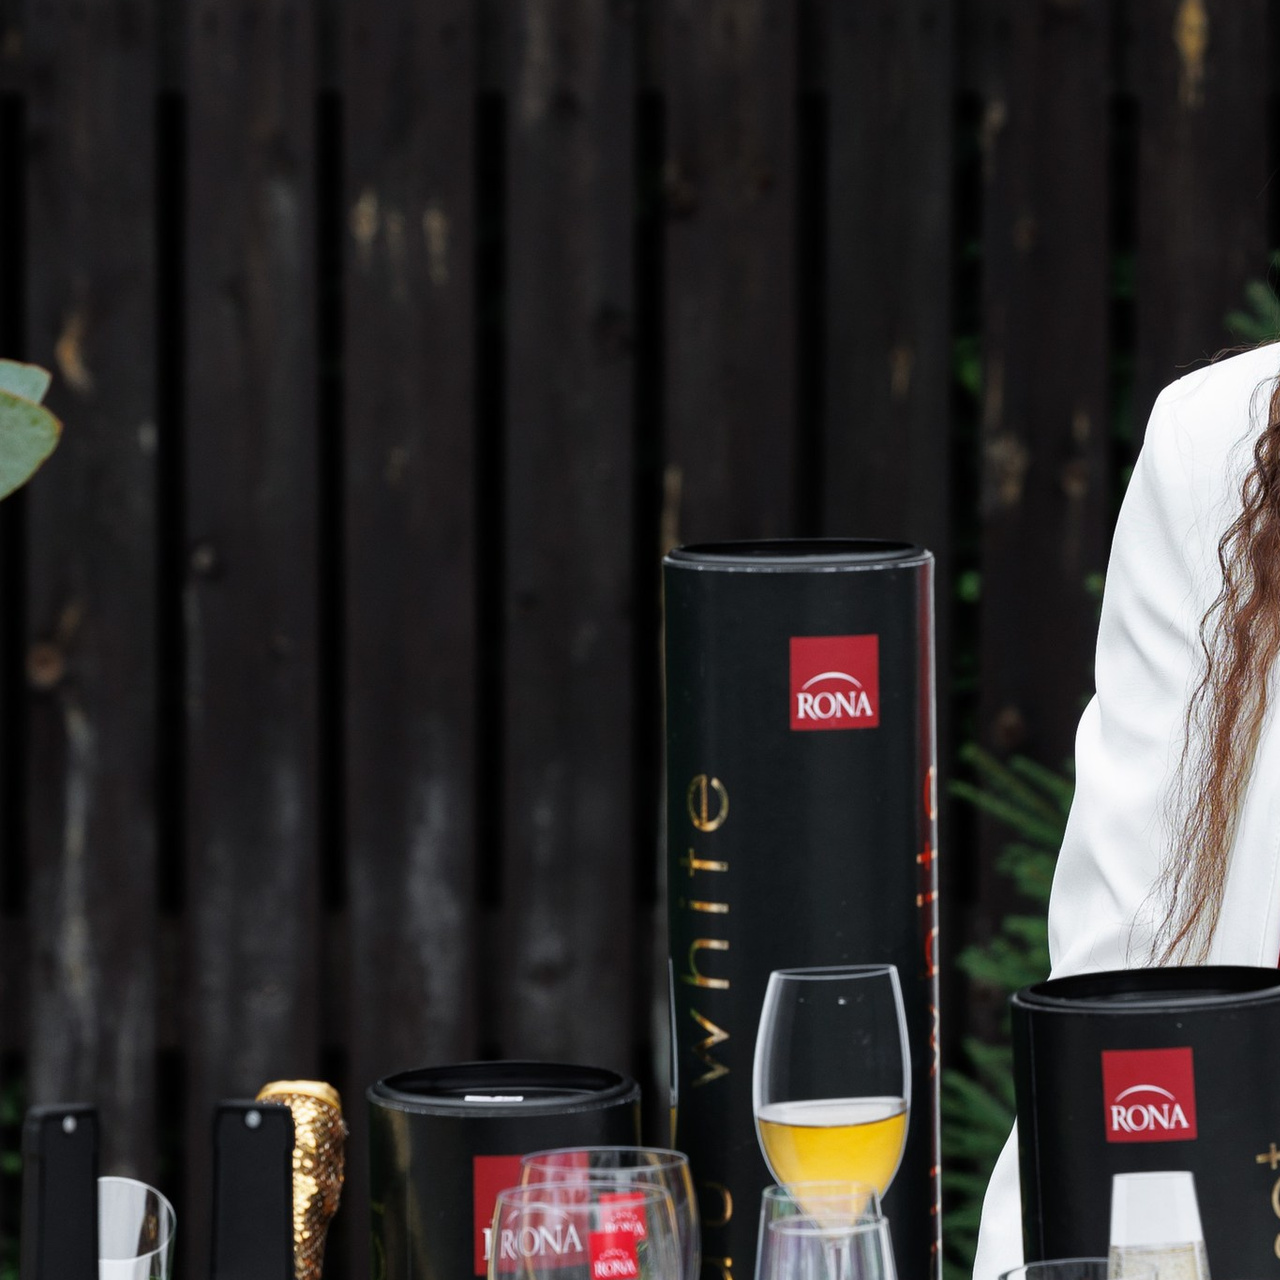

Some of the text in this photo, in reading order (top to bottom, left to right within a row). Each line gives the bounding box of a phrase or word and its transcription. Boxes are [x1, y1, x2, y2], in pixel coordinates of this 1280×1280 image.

[797, 690, 873, 721] RONA
[681, 773, 730, 1087] white
[1110, 1103, 1190, 1133] RONA
[482, 1223, 583, 1260] RONA
[594, 1259, 637, 1278] RONA
